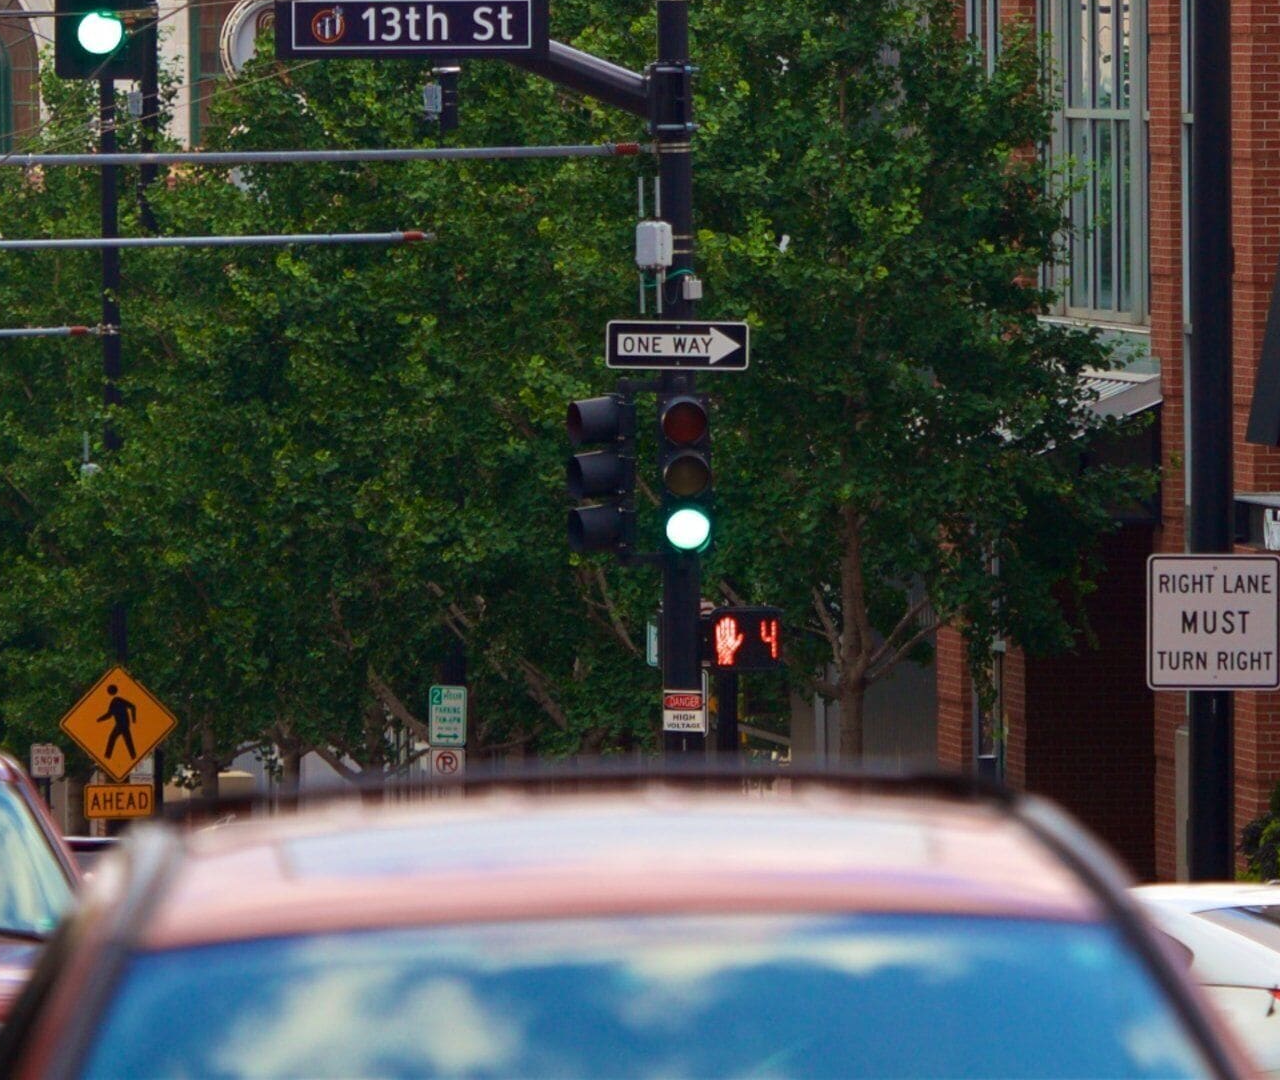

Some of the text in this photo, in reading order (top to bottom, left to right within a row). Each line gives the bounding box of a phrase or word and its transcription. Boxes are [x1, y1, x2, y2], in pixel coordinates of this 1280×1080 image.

[362, 5, 514, 42] 13th St
[623, 336, 713, 353] ONE WAY
[1159, 574, 1271, 594] RIGHT LANE
[1182, 611, 1249, 634] MUST
[761, 620, 778, 658] 4
[1157, 651, 1272, 670] TURN RIGHT
[433, 689, 440, 703] 2
[669, 695, 700, 707] DANGER
[34, 756, 60, 766] SNOW
[91, 792, 148, 810] AHEAD
